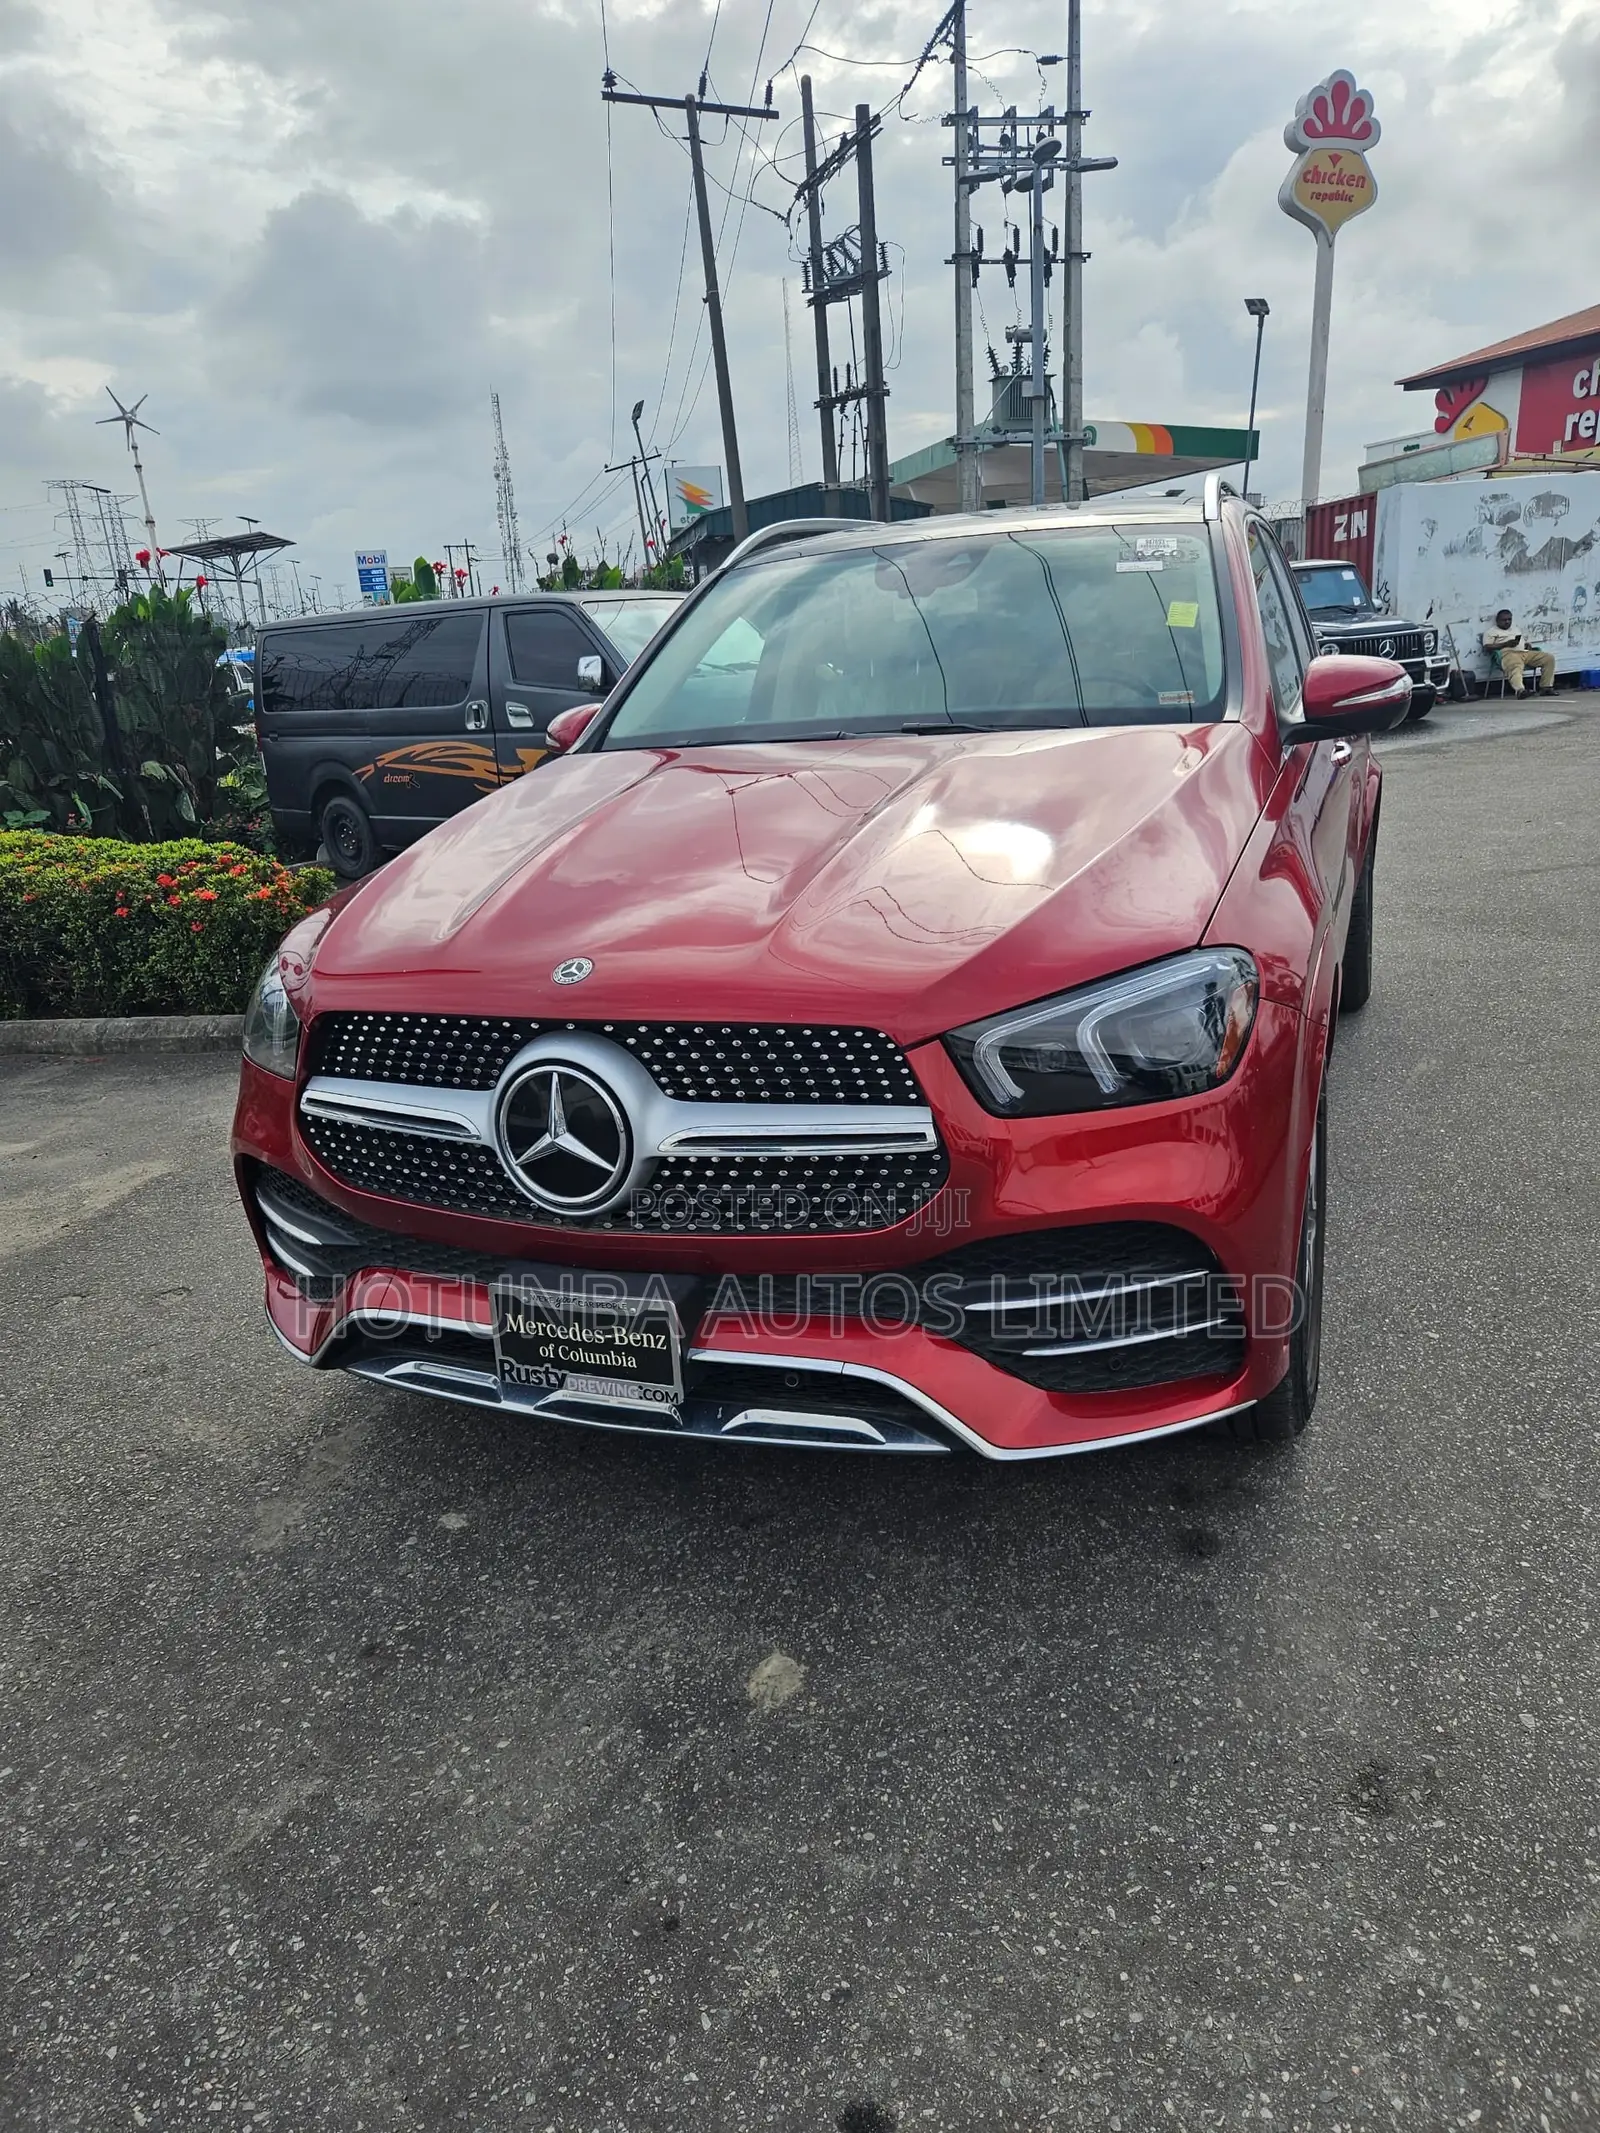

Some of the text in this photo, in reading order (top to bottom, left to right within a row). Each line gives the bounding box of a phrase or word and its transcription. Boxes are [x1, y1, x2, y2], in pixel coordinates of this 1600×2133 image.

[1302, 164, 1367, 188] chicken
[1310, 189, 1355, 203] republic
[357, 554, 386, 565] Mobil
[578, 1300, 596, 1308] CAR
[505, 1313, 668, 1350] Mercedes-Benz
[539, 1343, 638, 1369] of Columbia
